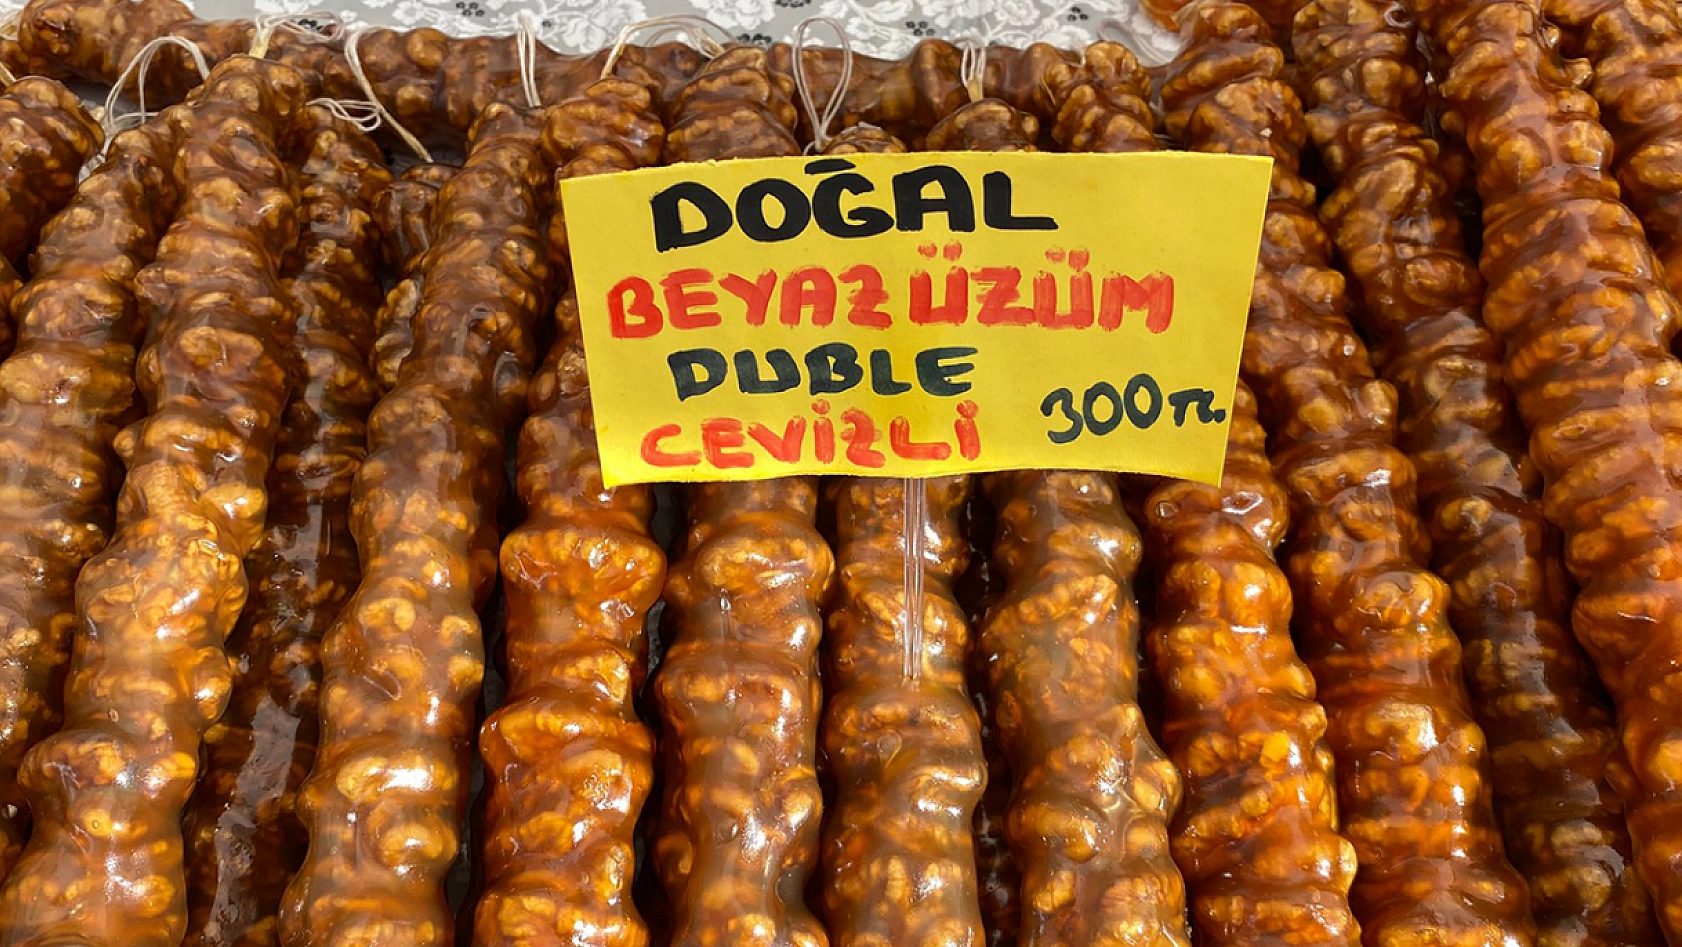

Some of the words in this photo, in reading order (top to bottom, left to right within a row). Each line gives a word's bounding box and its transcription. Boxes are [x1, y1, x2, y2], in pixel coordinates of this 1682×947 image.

[649, 158, 1059, 253] DOĞAL
[606, 264, 893, 339] BEYAZ
[908, 243, 1175, 334] ÜZÜM
[667, 342, 979, 403] DUBLE
[640, 401, 982, 469] CEVİZLİ
